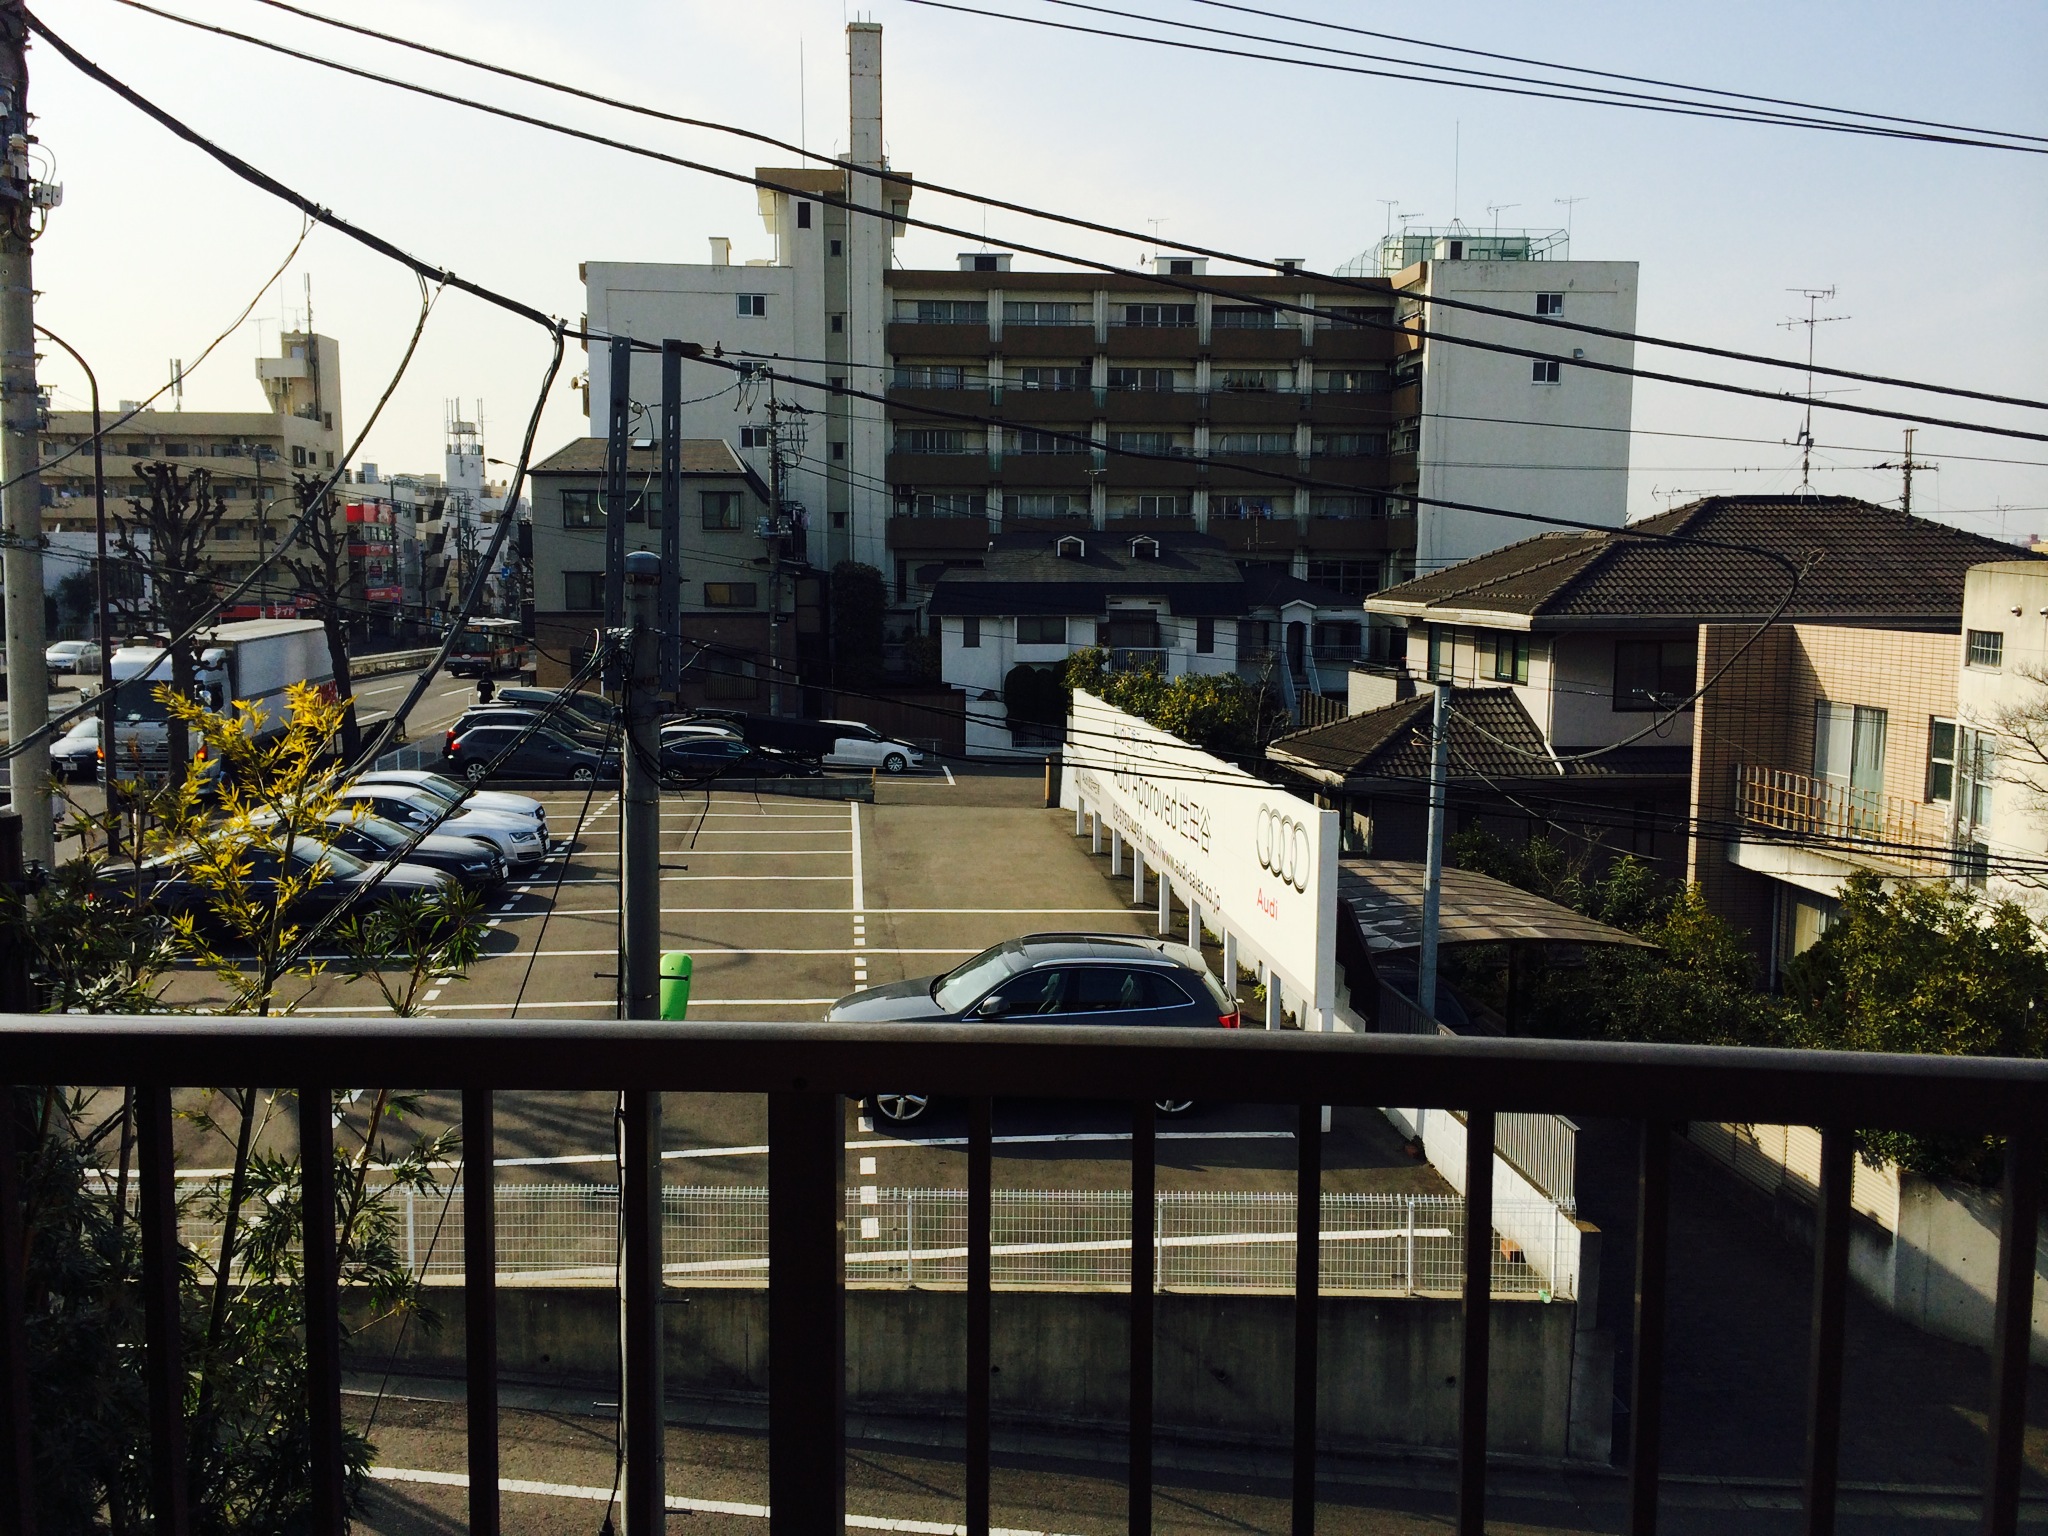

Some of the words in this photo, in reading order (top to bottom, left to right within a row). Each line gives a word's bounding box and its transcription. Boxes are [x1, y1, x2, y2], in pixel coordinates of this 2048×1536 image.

[1132, 762, 1177, 831] Approved
[1180, 792, 1211, 858] 世田谷
[1257, 887, 1278, 921] Audi
